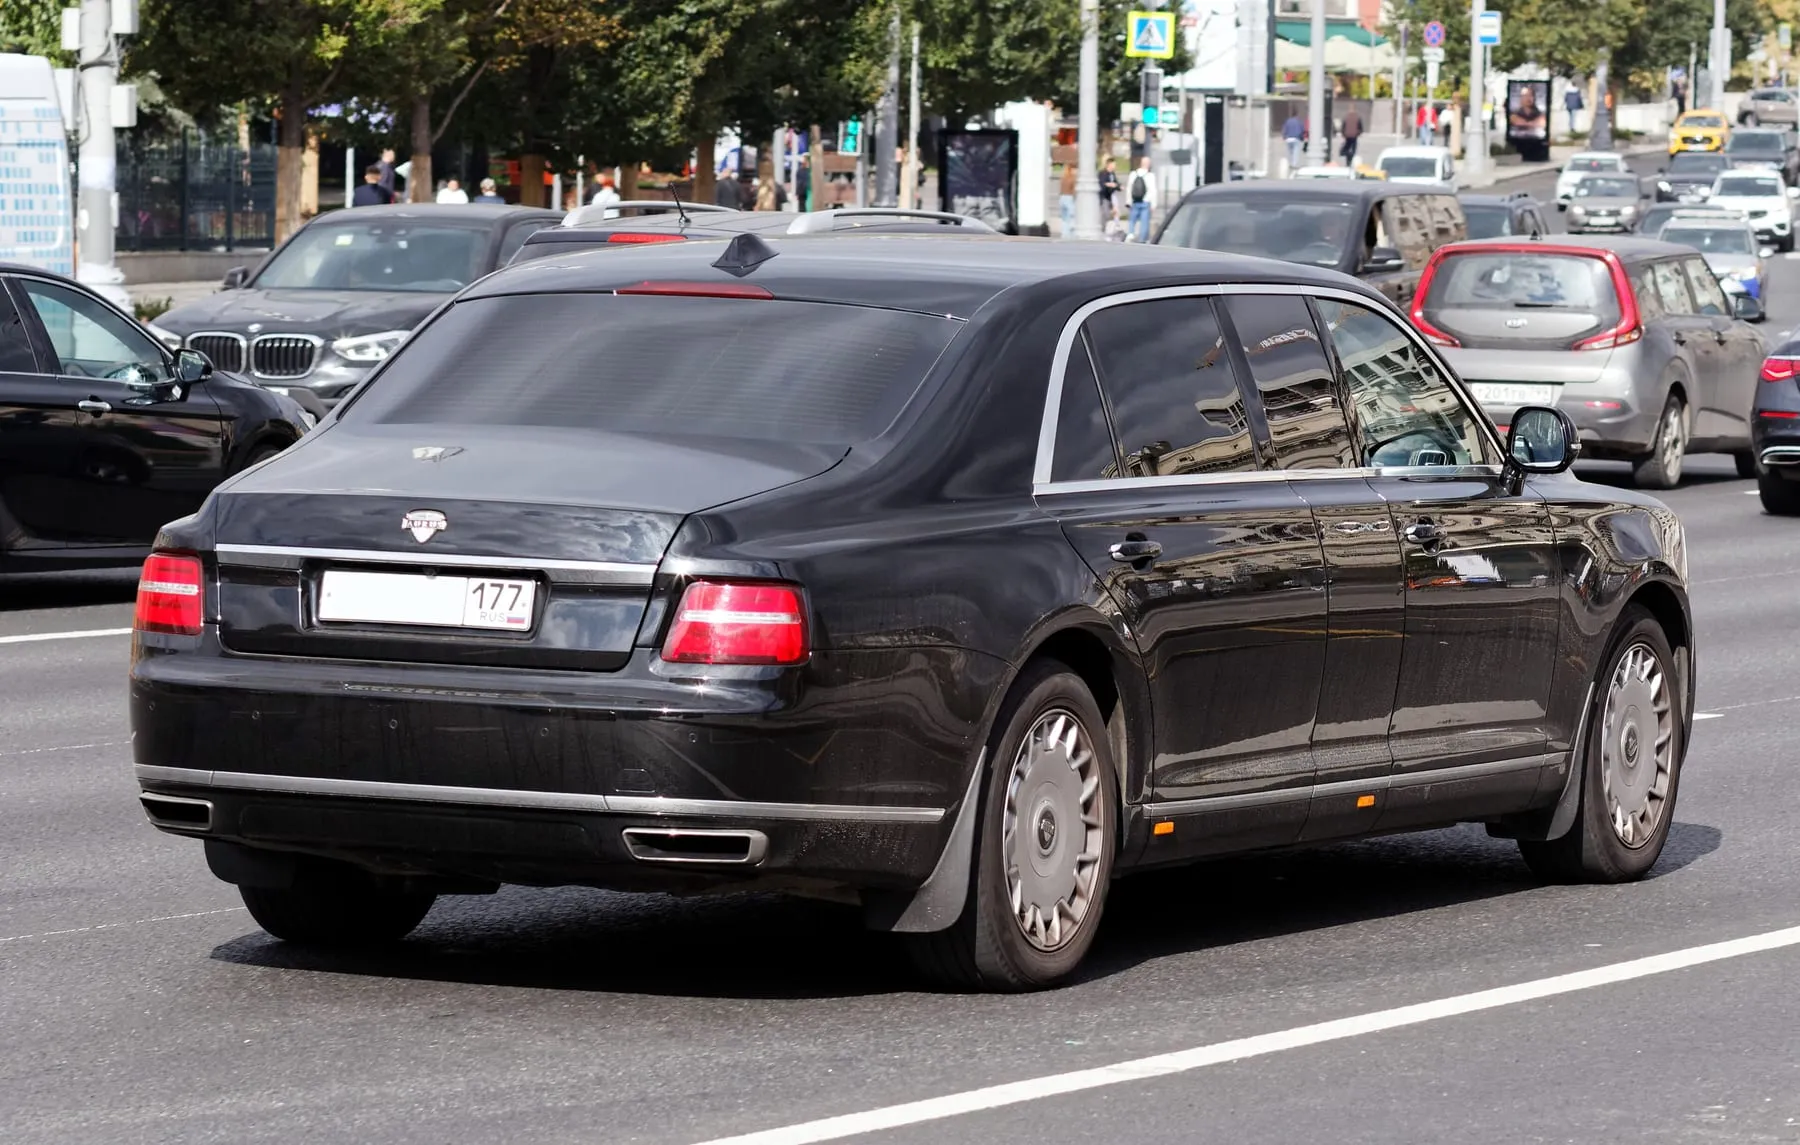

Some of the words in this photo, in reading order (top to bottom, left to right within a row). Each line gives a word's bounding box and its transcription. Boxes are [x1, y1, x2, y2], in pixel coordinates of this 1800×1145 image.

[407, 519, 446, 530] AURUS
[472, 582, 523, 611] 177
[480, 611, 505, 622] RUS
